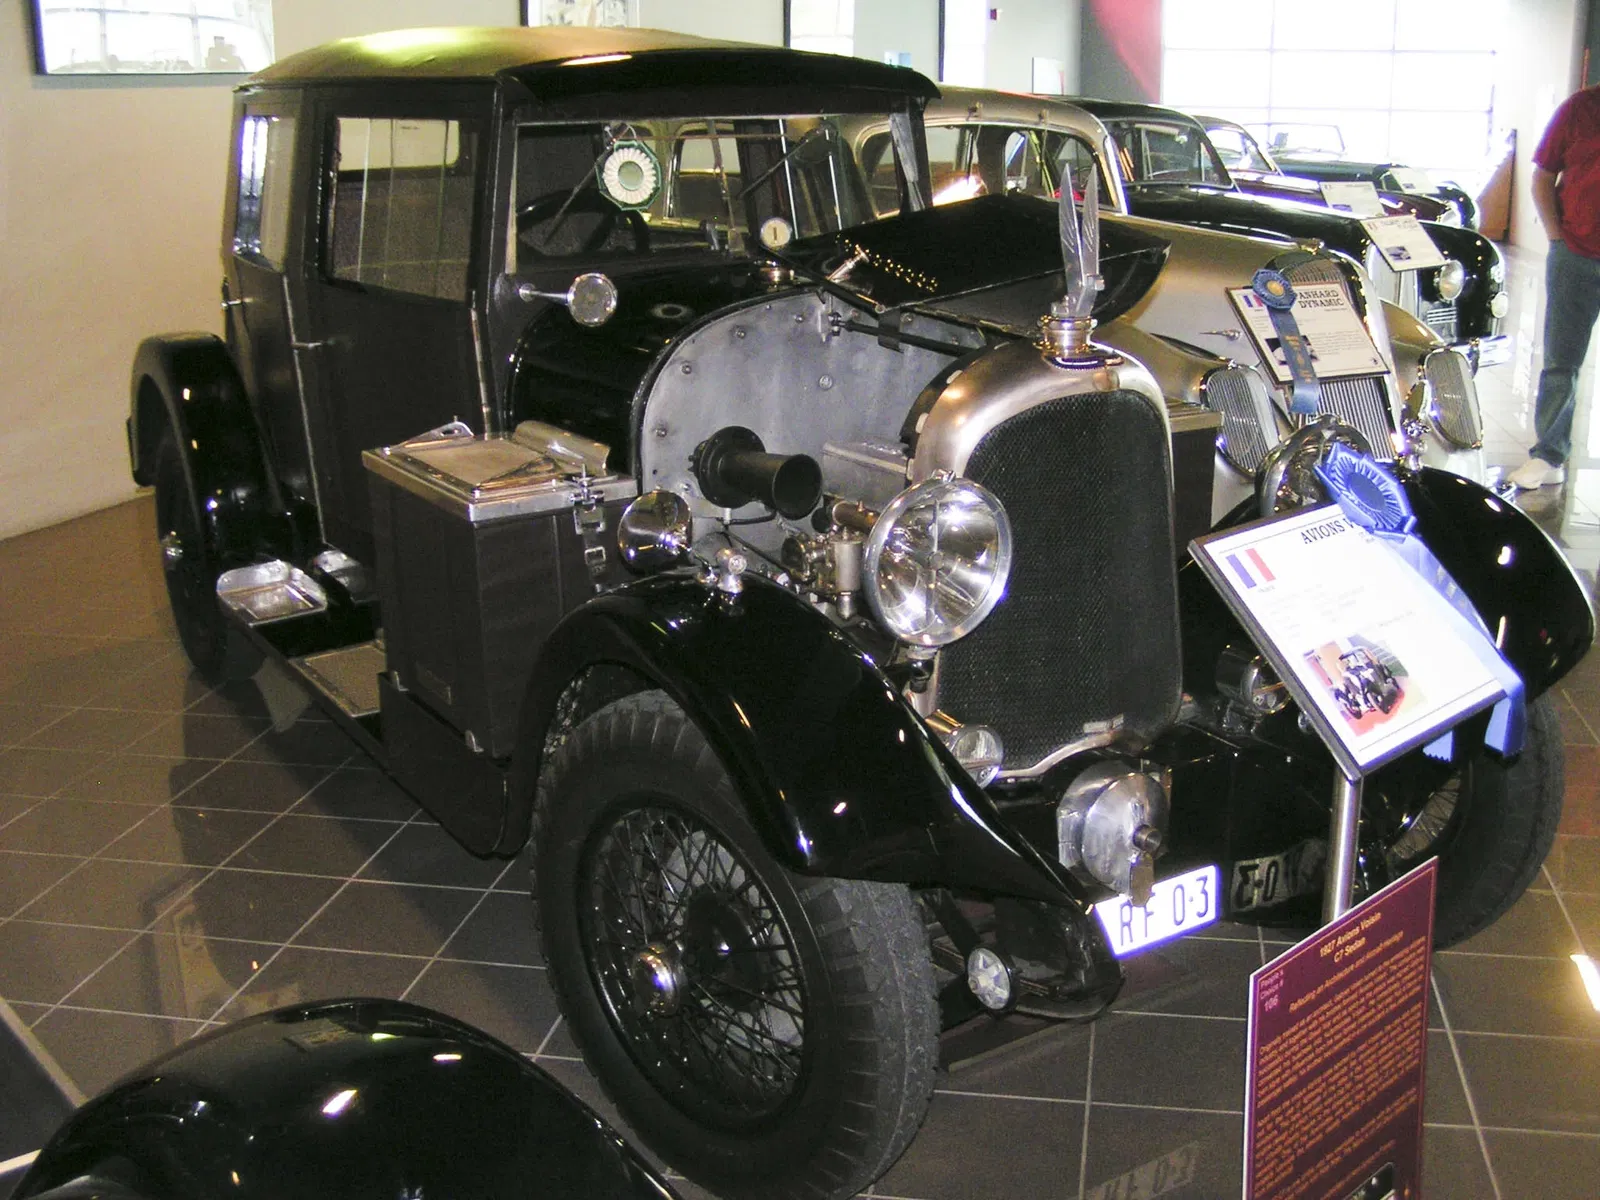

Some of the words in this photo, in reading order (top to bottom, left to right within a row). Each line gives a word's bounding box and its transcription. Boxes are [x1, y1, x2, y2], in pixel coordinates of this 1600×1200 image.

[1298, 289, 1339, 299] ANHARD
[1298, 298, 1345, 308] DYNAMIC
[1300, 519, 1346, 545] AVIONS
[1320, 940, 1336, 958] 1927
[1336, 926, 1360, 945] Avions
[1360, 912, 1382, 930] Voisin
[1334, 949, 1344, 963] C7
[1344, 936, 1366, 956] Sedan
